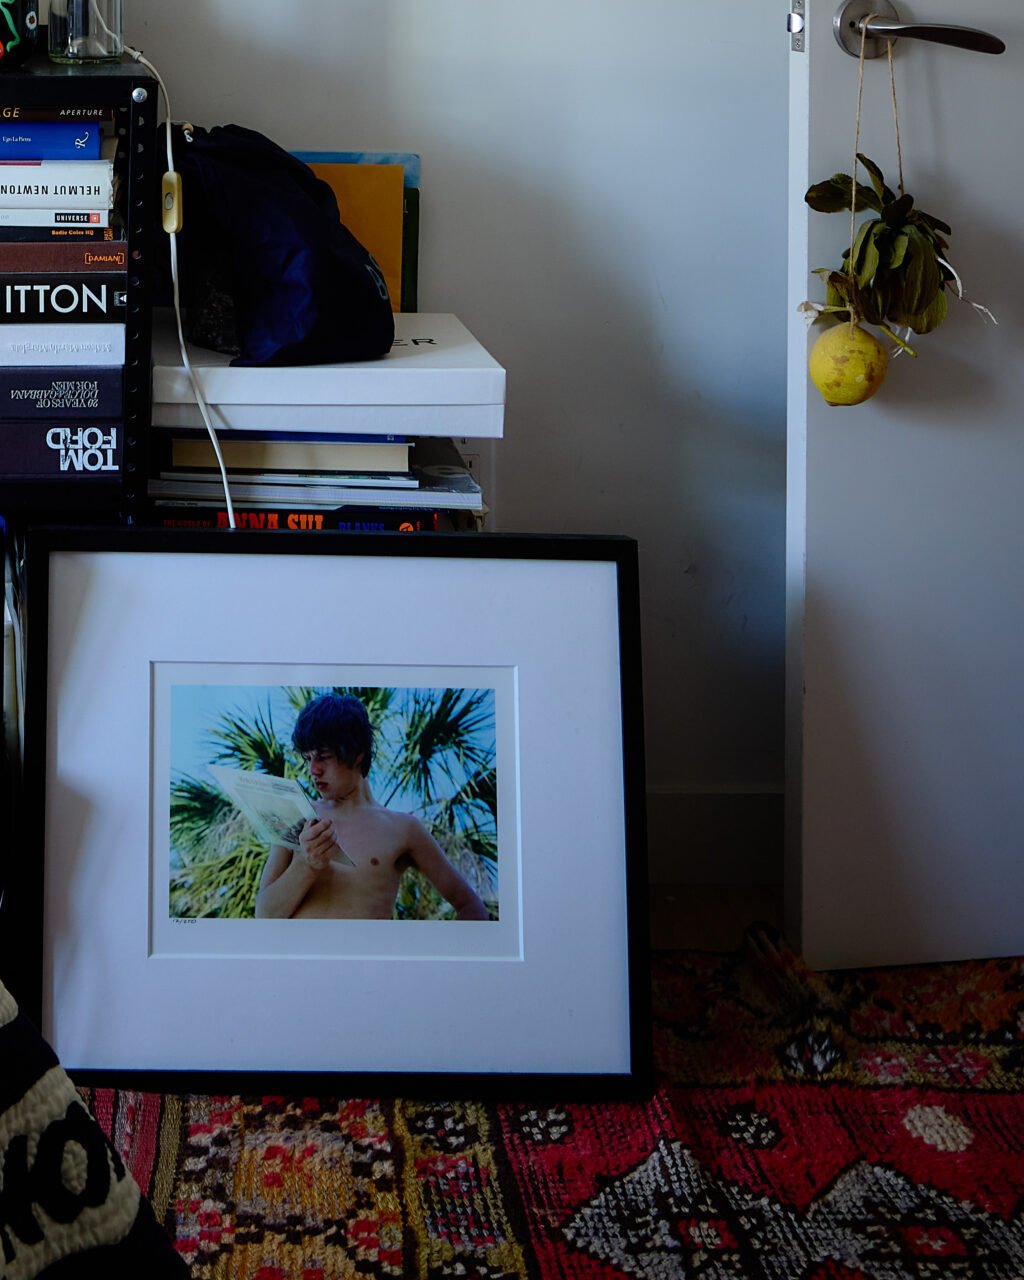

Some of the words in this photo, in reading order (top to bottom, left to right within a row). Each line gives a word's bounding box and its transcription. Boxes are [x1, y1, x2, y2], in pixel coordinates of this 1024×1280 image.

[0, 184, 49, 195] NEWTON
[53, 184, 100, 195] HELMUT
[56, 214, 89, 222] UNIVERSE
[51, 380, 76, 390] MEN
[75, 380, 99, 390] FOR
[36, 399, 51, 408] OF
[52, 399, 87, 408] YEARS
[87, 399, 99, 408] 20
[45, 427, 117, 450] FORD
[59, 449, 120, 471] TOM
[288, 513, 324, 530] SUI
